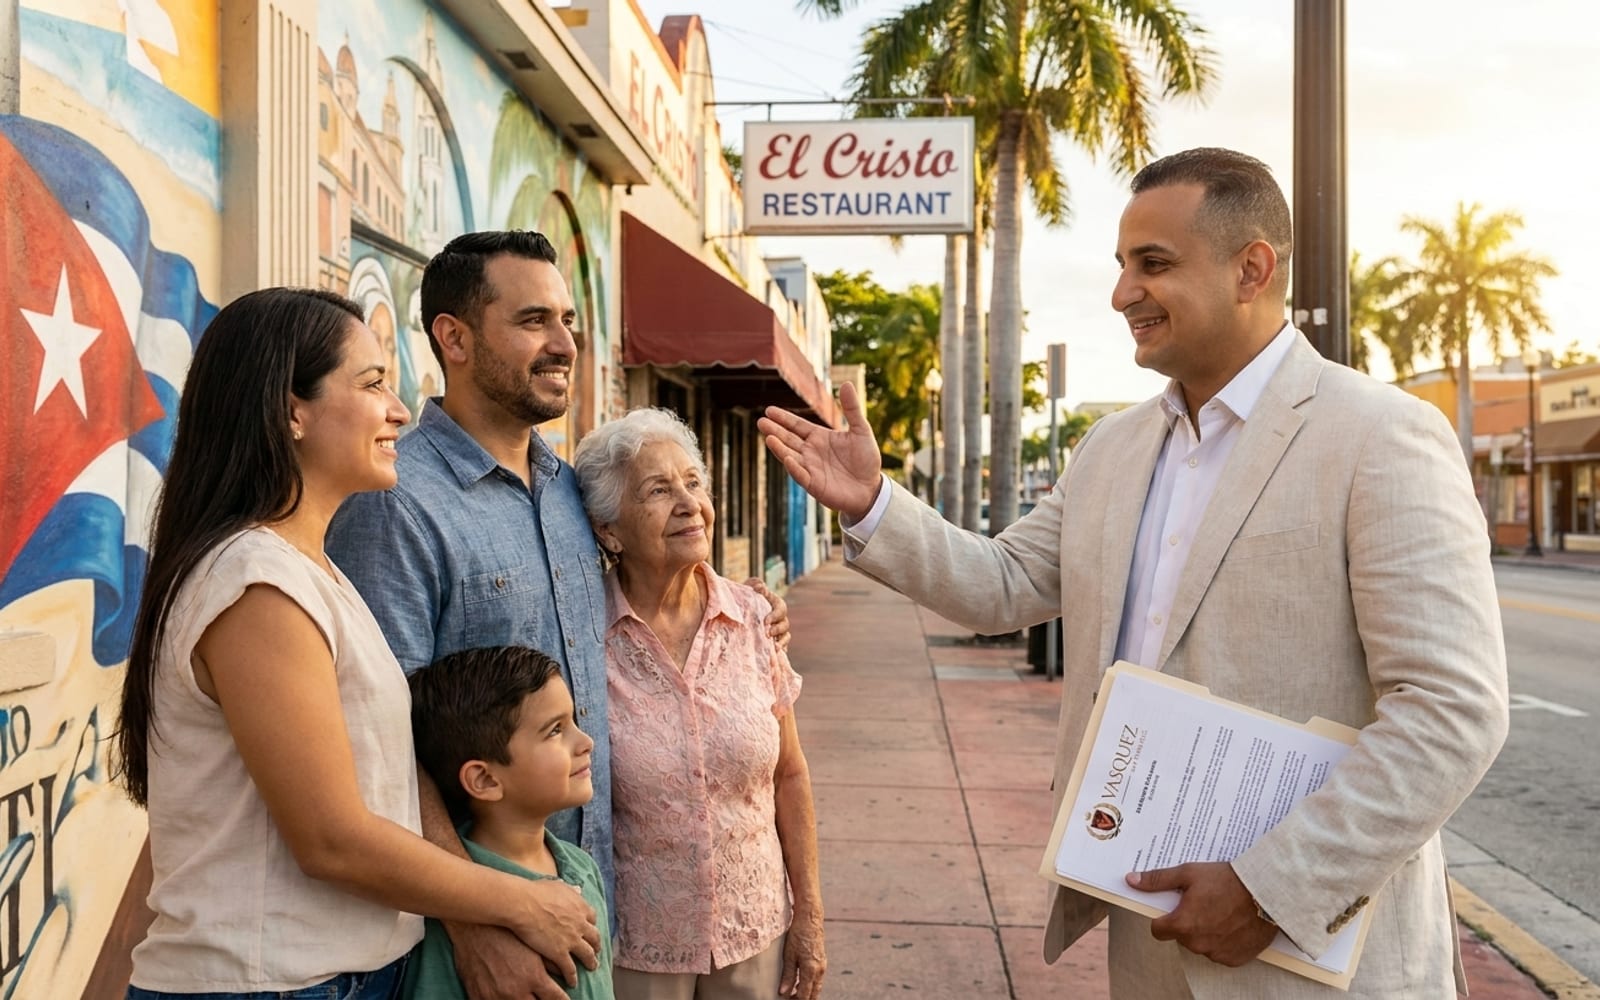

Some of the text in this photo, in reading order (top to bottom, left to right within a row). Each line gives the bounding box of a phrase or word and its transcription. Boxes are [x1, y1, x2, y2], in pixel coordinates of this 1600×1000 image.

[759, 132, 958, 179] El Cristo
[763, 191, 952, 217] RESTAURANT
[1101, 724, 1139, 798] VASQUEZ
